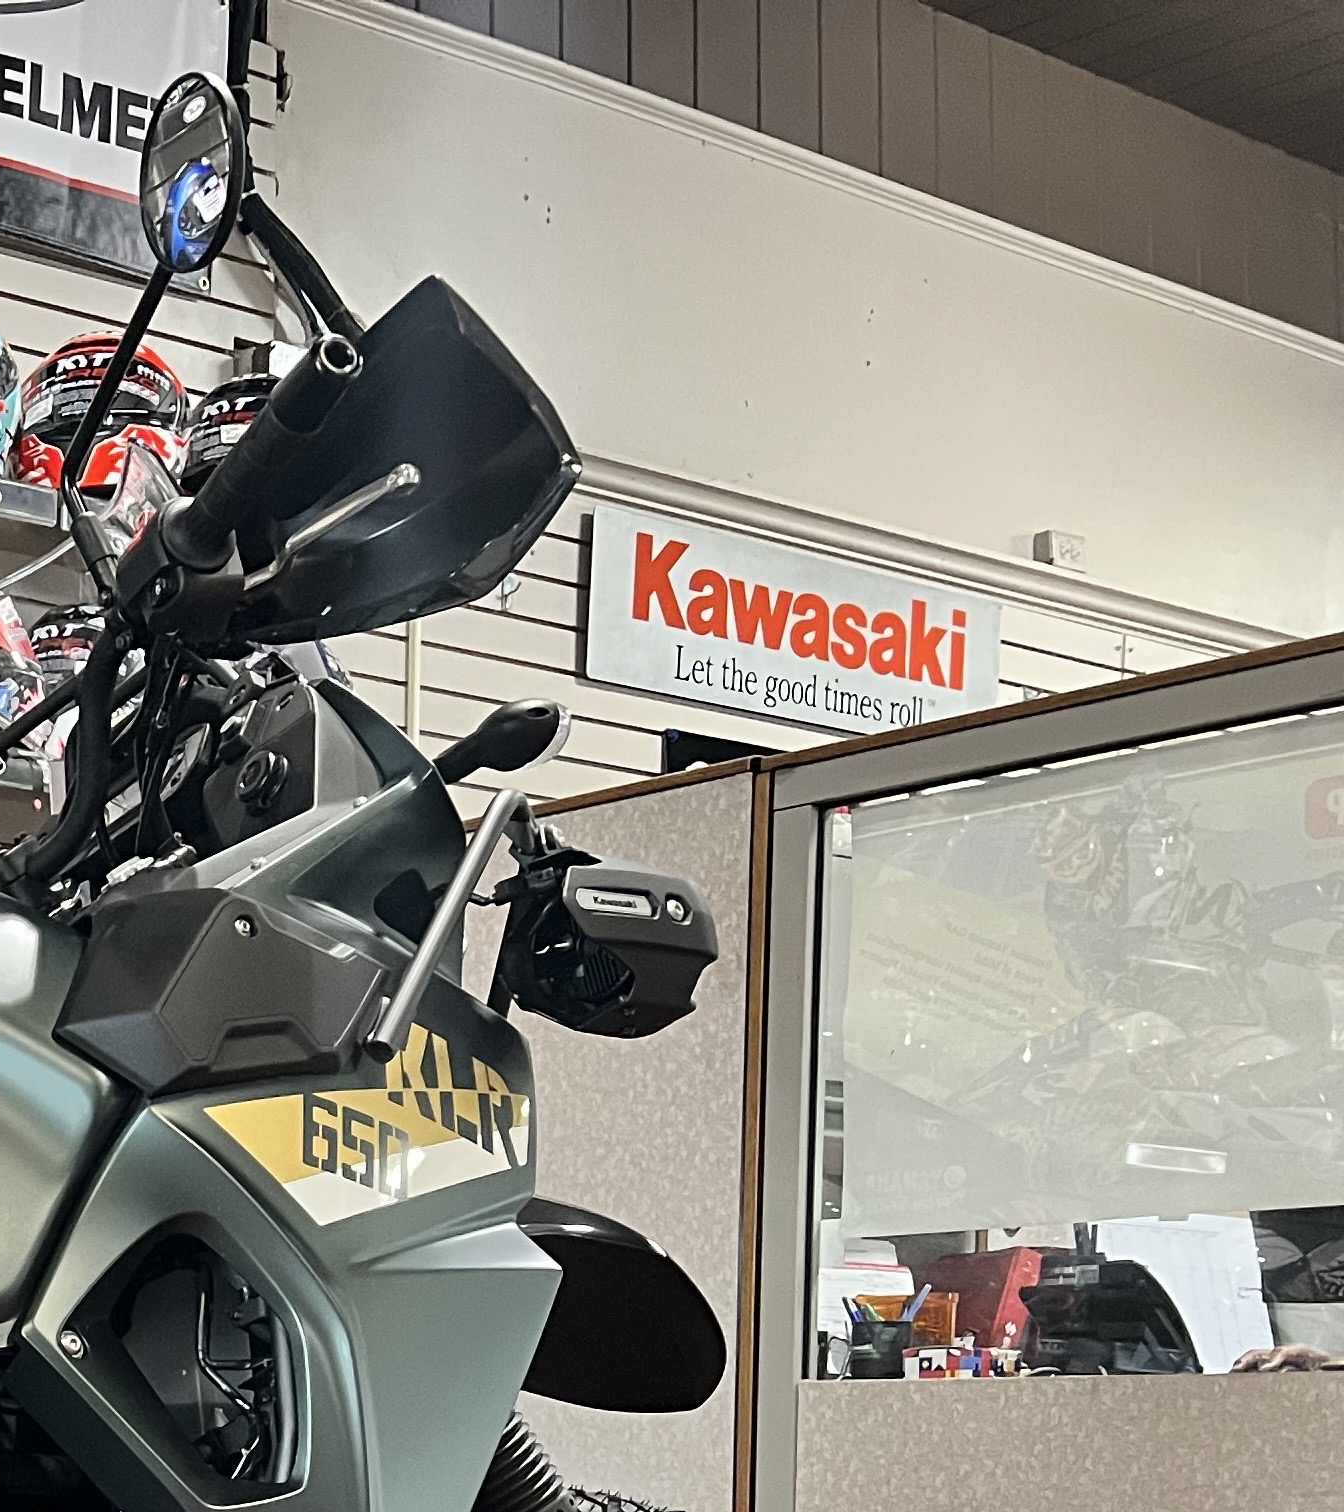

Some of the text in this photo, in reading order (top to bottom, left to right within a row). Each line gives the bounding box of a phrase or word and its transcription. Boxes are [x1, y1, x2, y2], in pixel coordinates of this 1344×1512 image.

[632, 531, 967, 691] Kawasaki
[673, 644, 714, 686] Let
[722, 658, 758, 695] the
[763, 674, 818, 708] good
[824, 678, 883, 721] times
[889, 696, 924, 727] roll
[302, 1092, 410, 1200] 650
[384, 1023, 519, 1170] KLR
